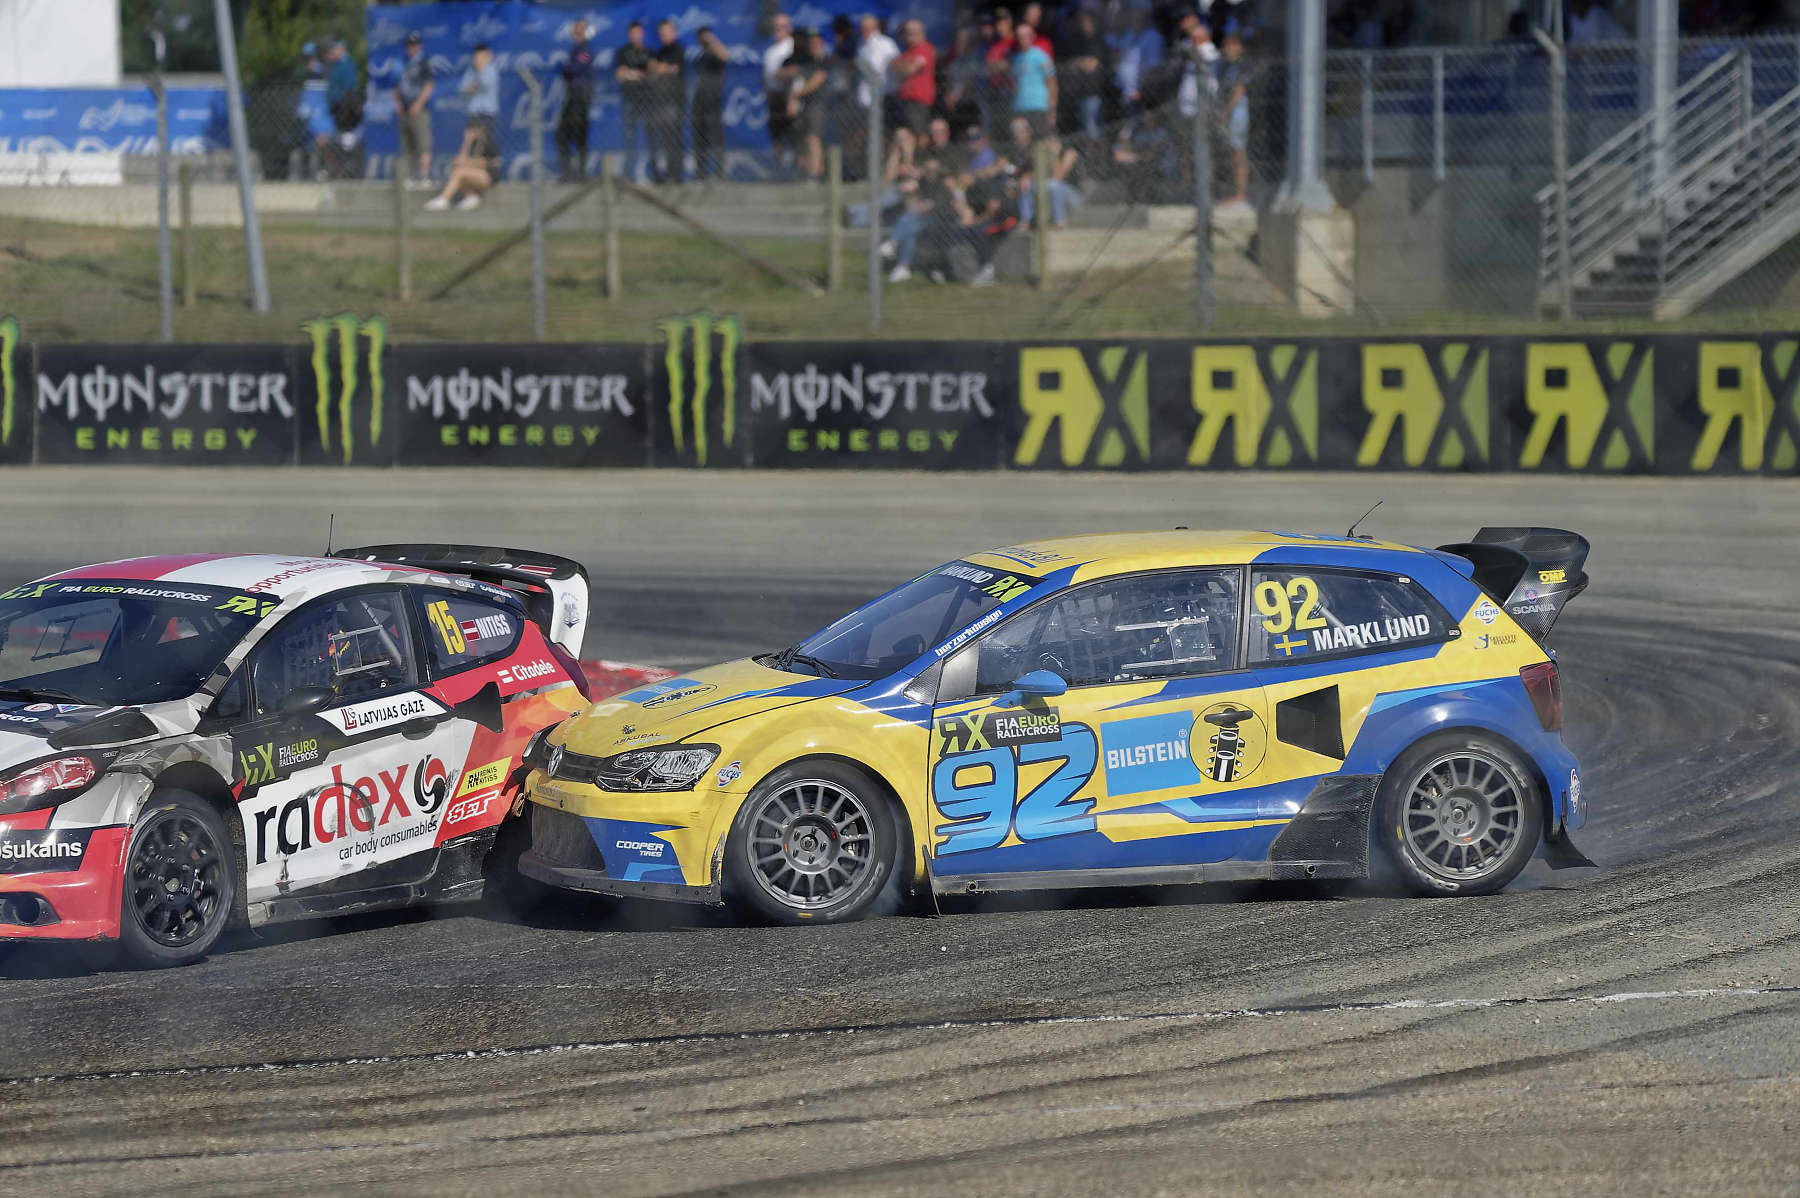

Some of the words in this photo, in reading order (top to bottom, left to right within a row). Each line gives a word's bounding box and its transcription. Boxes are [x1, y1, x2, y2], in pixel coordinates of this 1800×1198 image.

[37, 365, 293, 421] MONSTER
[406, 367, 634, 420] MONSTER
[749, 363, 993, 422] MONSTER
[75, 428, 256, 450] ENERGY
[441, 425, 599, 446] ENERGY
[787, 429, 959, 452] ENERGY
[82, 586, 124, 594] EURO
[122, 587, 212, 602] RALLYCROSS
[1254, 577, 1327, 634] 92
[1474, 609, 1500, 617] FUCHS
[1512, 603, 1556, 615] SCANIA
[427, 600, 466, 655] 15
[475, 613, 511, 639] NITISS
[1312, 614, 1431, 651] MARKLUND
[511, 659, 556, 681] Citadele
[358, 705, 399, 726] LATVIJAS
[997, 725, 1060, 739] RALLYCROSS
[1107, 739, 1188, 769] BILSTEIN
[932, 721, 1099, 858] 92
[253, 763, 412, 866] radex
[339, 842, 353, 861] car
[355, 833, 379, 858] body
[380, 817, 438, 848] consumables
[616, 840, 665, 851] COOPER
[640, 850, 662, 858] TIRES
